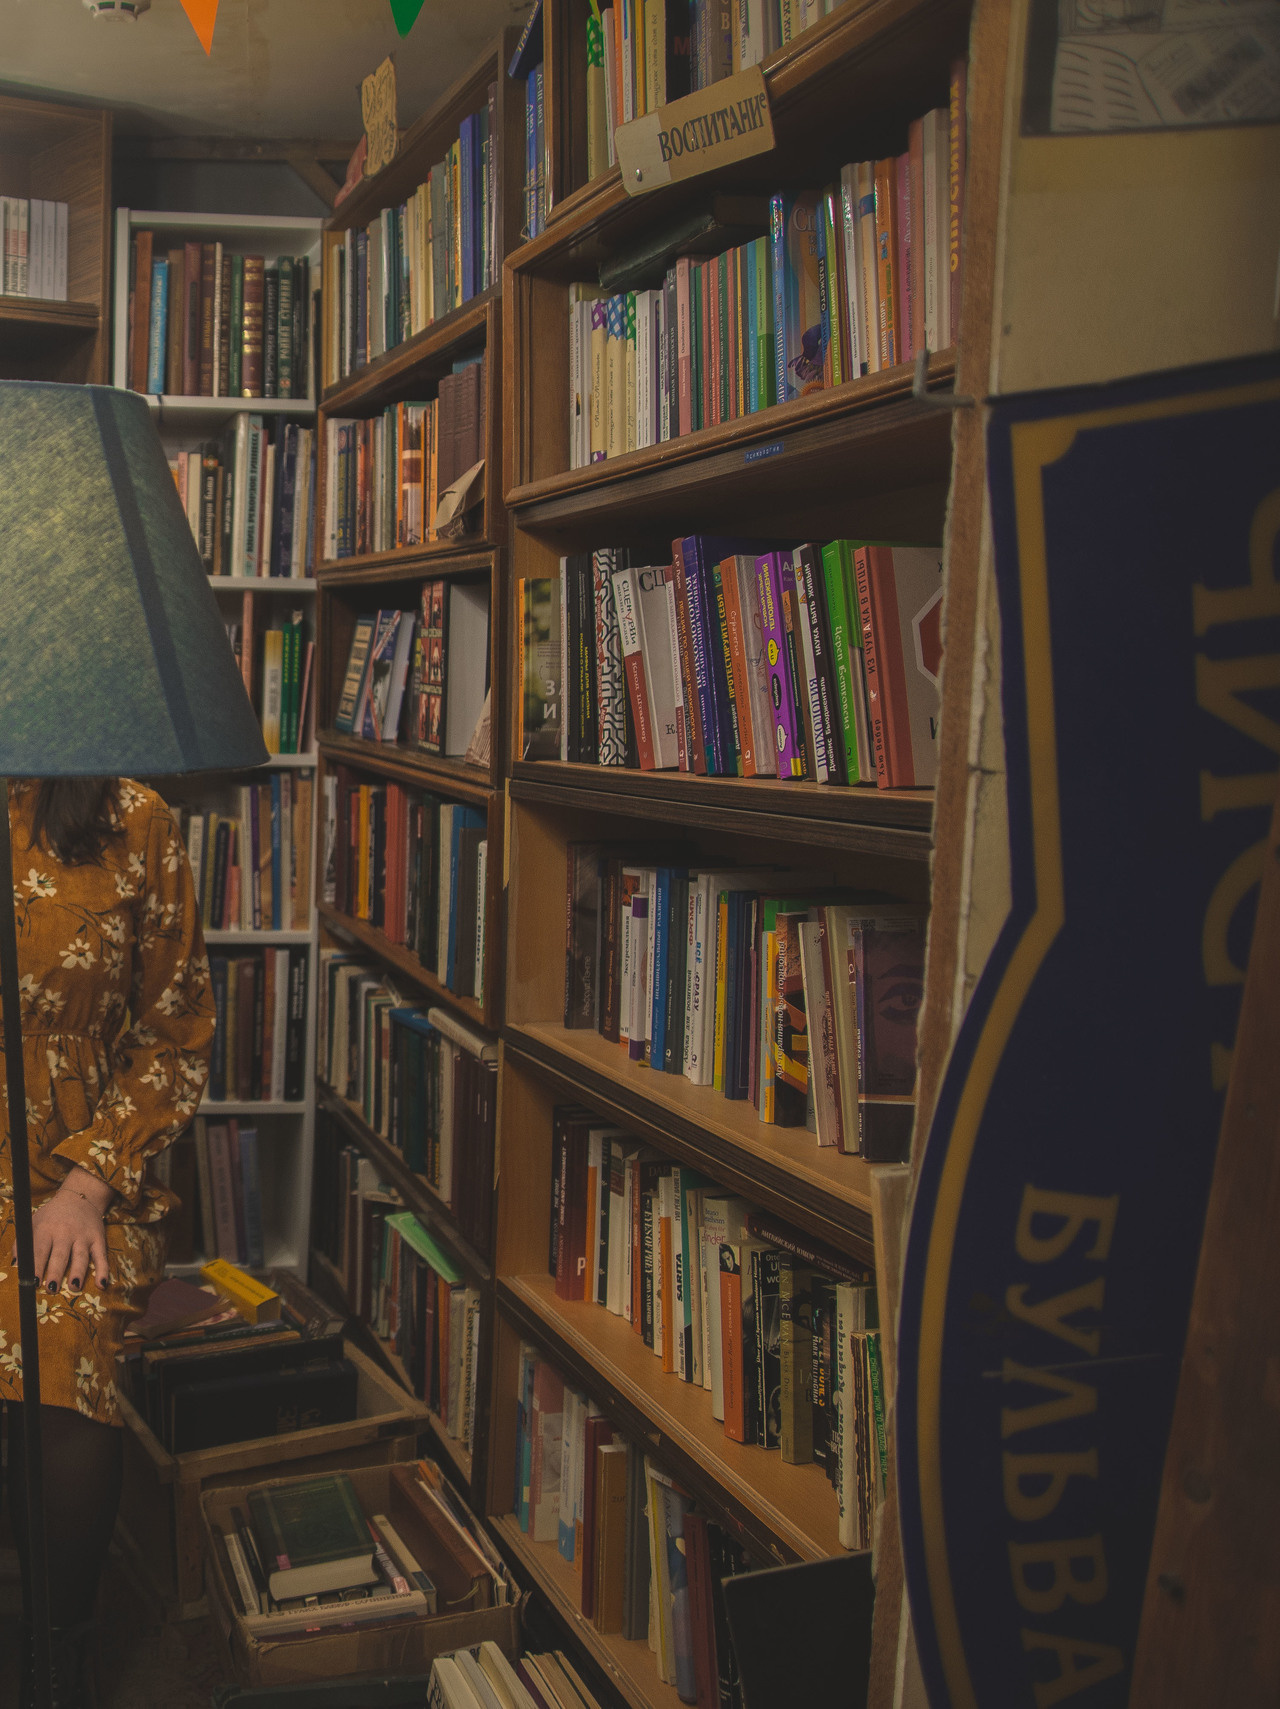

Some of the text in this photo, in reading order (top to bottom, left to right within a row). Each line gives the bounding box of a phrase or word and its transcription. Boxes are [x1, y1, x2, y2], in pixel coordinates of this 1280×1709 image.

[248, 476, 256, 523] РЕКОРДОВ
[757, 572, 765, 597] ЯЗЫК
[762, 563, 775, 631] ТЕЛОДВИЖЕНИЙ
[857, 559, 867, 592] ОТЦЫ
[716, 593, 725, 618] СЕБЯ
[681, 635, 686, 647] ПО
[684, 576, 702, 689] ПСИХОМОТОРНАЯ
[692, 572, 707, 687] ОРГАНИЗАЦИЯ ЧЕЛОВЕКА
[730, 610, 741, 657] Стратегия
[862, 608, 873, 654] ЧУВАКА
[682, 650, 690, 680] ОБЩЕЙ
[720, 620, 735, 699] ПРОТЕСТИРУЙТЕ
[804, 563, 836, 772] Джеймс Бьюдженталь НАУКА БЫТЬ ЖИВЫМ
[835, 625, 849, 730] Череп Бетховена
[868, 658, 876, 674] ИЗ
[632, 662, 648, 743] Клод Штайнер
[685, 684, 696, 741] ПСИХОЛОГИИ
[809, 677, 826, 768] ПСИХОЛОГИЯ
[874, 719, 882, 750] Вебер
[877, 754, 886, 777] Хью
[776, 941, 785, 988] горизонты
[760, 1229, 816, 1262] АНГЛИЙСКИЙ ЮМОР
[675, 1252, 683, 1302] SARITA
[780, 1262, 791, 1399] IAN McEWAN BLACK DOGS
[872, 1394, 881, 1412] HOW
[874, 1413, 882, 1423] TO
[876, 1424, 887, 1454] MANAGE
[1000, 1182, 1125, 1709] БУЛЬВА
[879, 1456, 888, 1477] THEM
